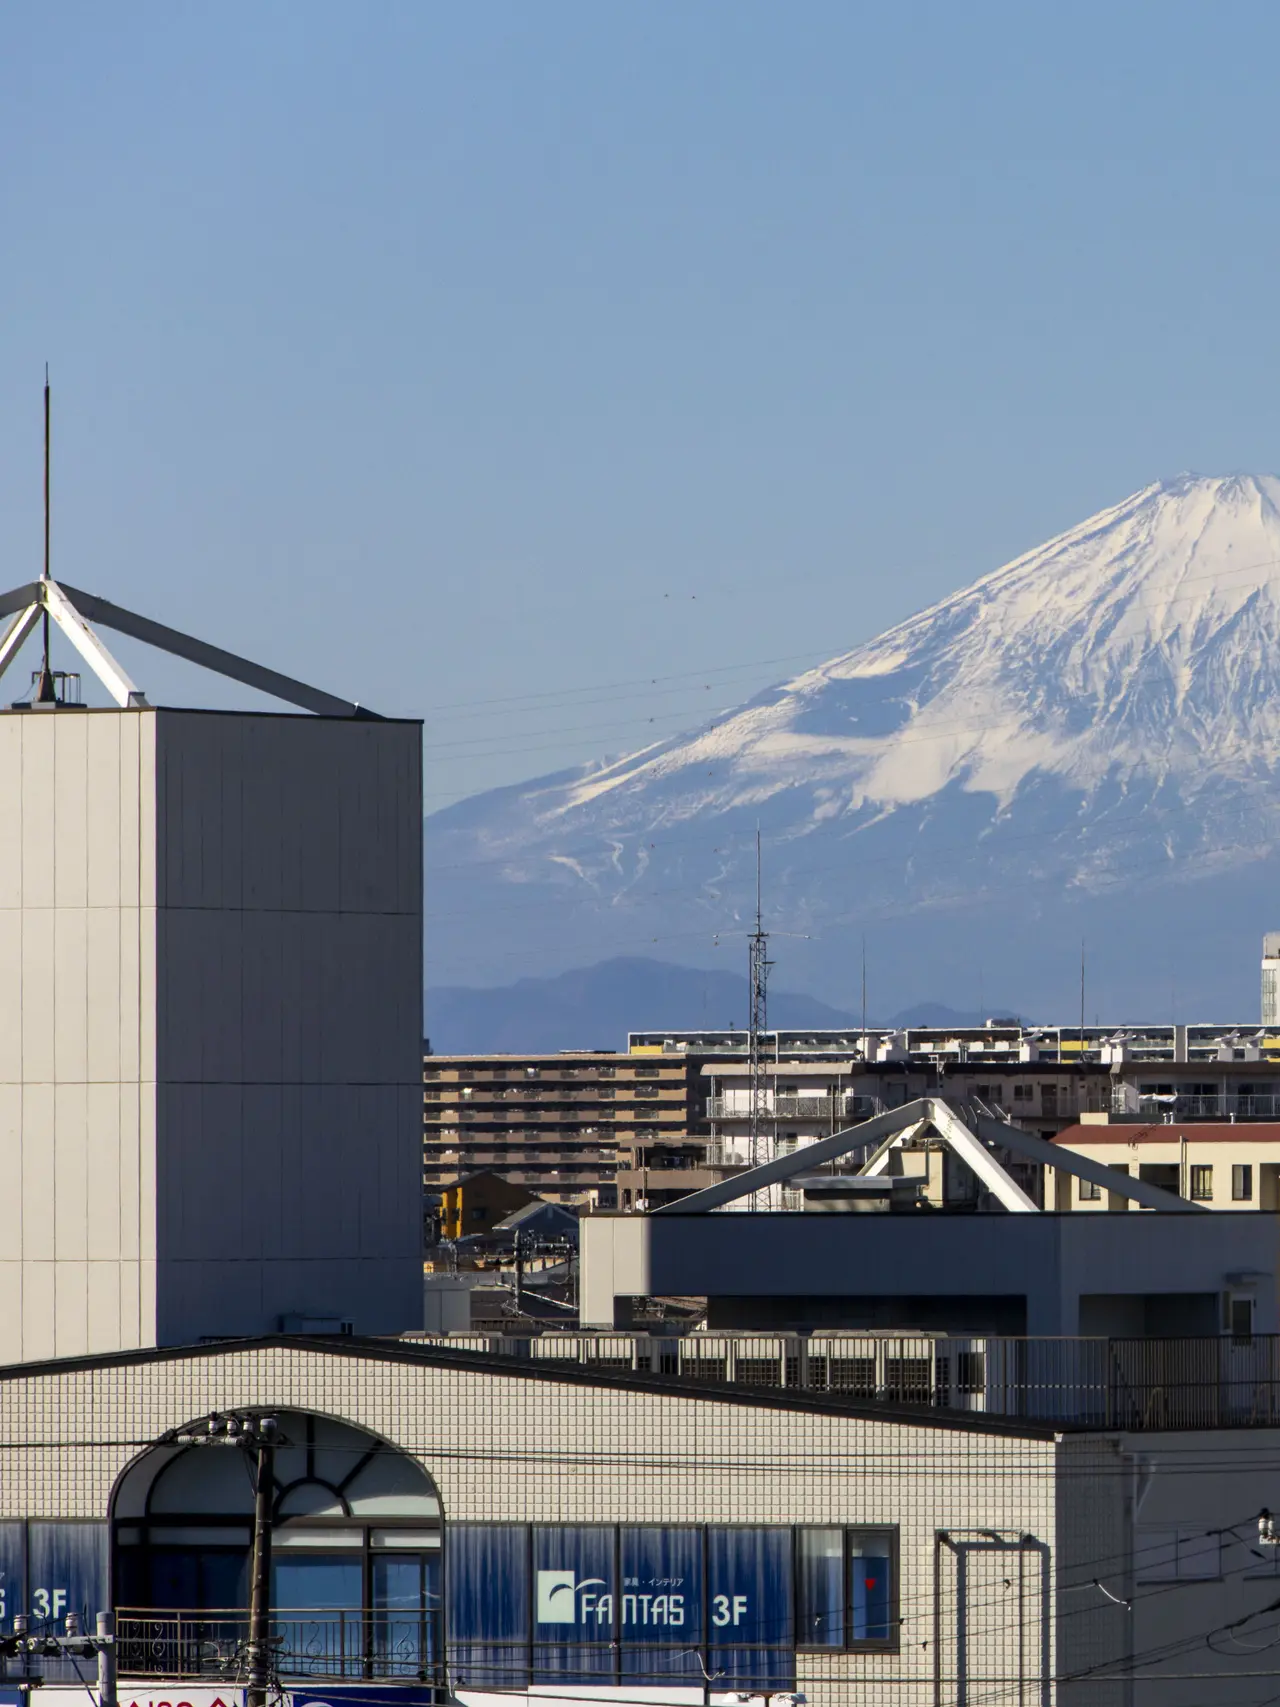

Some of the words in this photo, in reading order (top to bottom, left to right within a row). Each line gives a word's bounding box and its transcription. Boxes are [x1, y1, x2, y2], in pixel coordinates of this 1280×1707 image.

[32, 1588, 67, 1619] 3F
[581, 1594, 684, 1626] FANTAS
[712, 1595, 748, 1627] 3F
